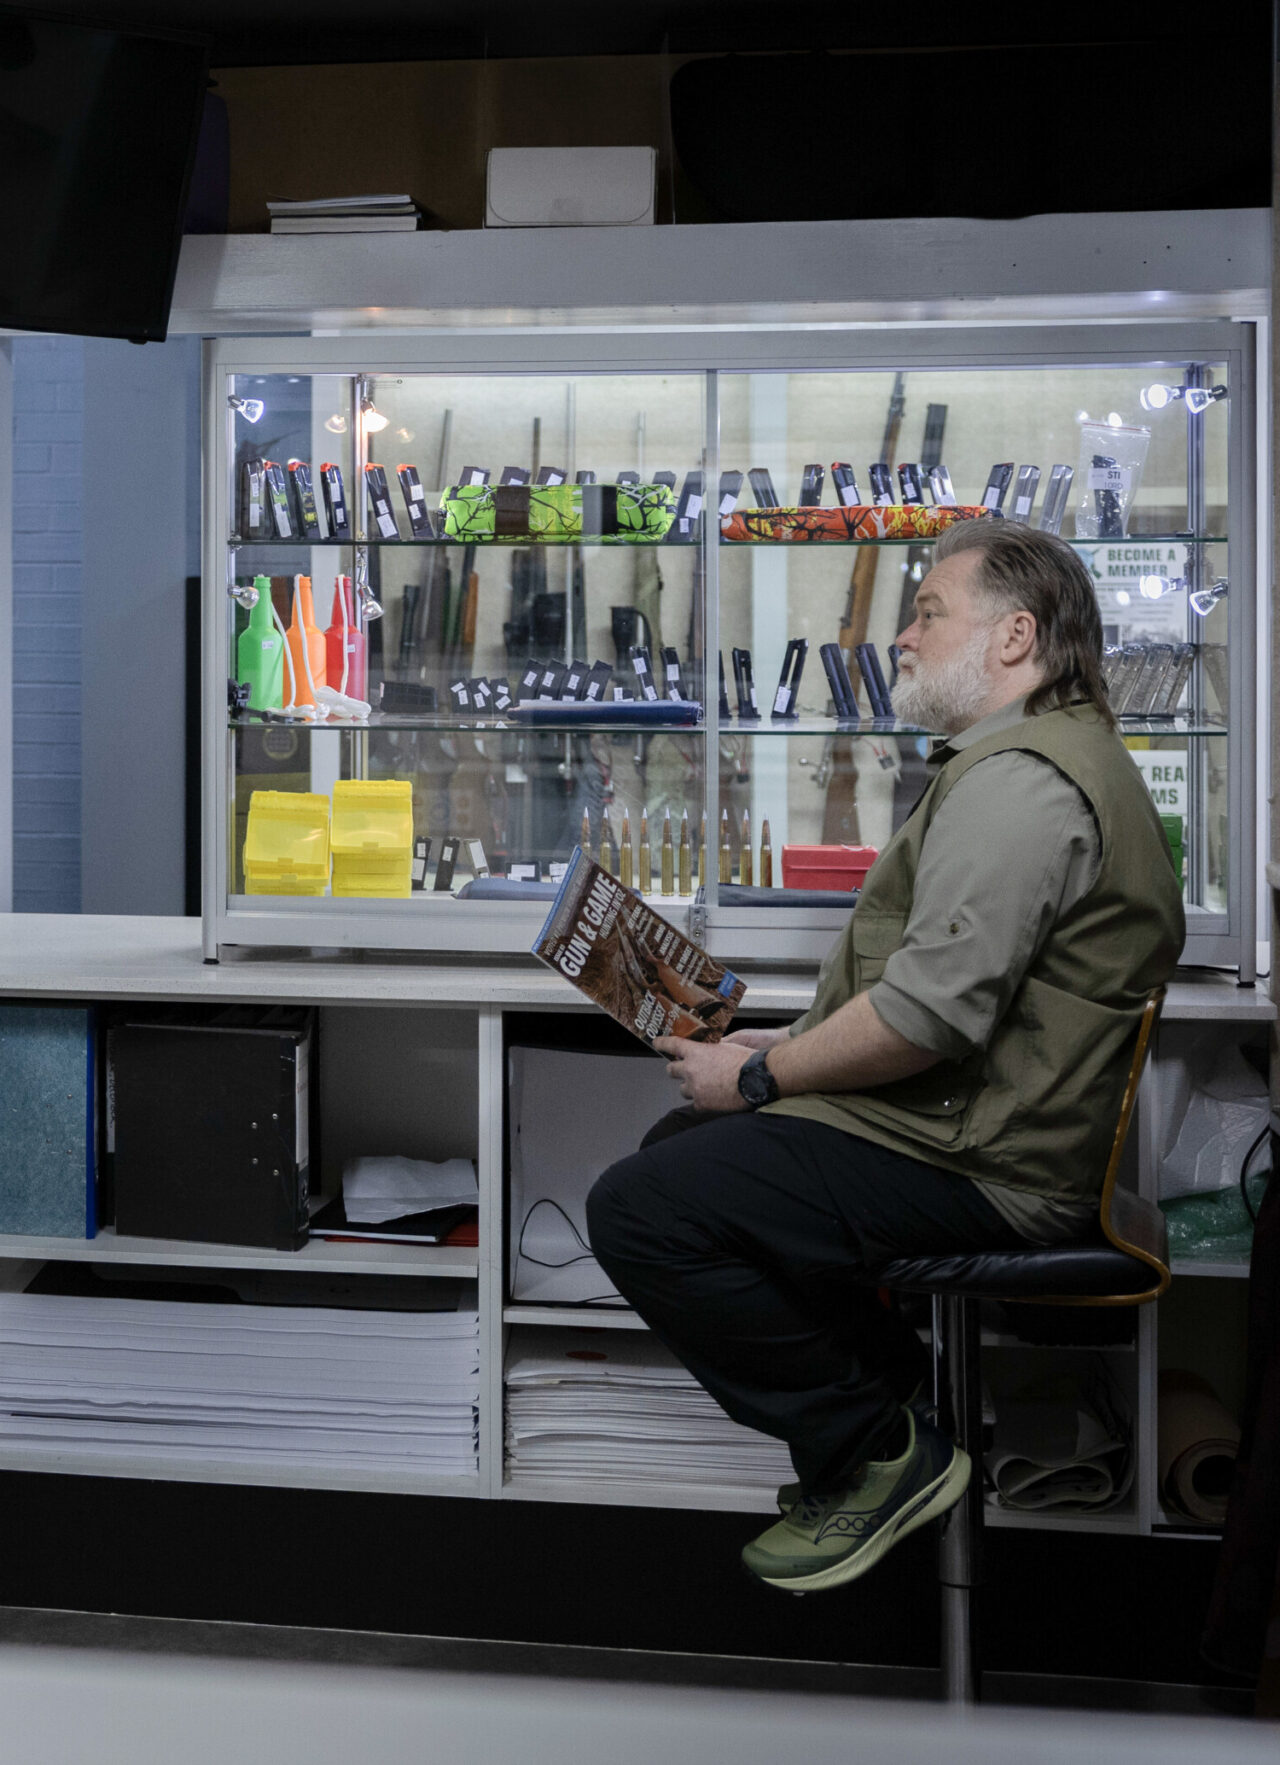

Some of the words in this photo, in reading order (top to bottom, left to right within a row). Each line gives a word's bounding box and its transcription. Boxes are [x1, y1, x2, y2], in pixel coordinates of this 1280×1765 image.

[1107, 471, 1121, 479] STI
[1107, 549, 1162, 562] BECOME
[1167, 549, 1176, 561] A
[1108, 565, 1168, 577] MEMBER
[1152, 766, 1188, 782] REA
[581, 871, 617, 926] GAME
[611, 898, 620, 909] IN
[614, 887, 625, 901] OZ
[576, 919, 597, 941] &
[598, 906, 618, 939] HUNTING
[653, 923, 666, 942] AMMO
[658, 929, 674, 955] ANALYSIS
[558, 932, 592, 978] GUN
[679, 944, 692, 964] TARGET
[633, 989, 657, 1030] OUTBACK
[644, 1000, 667, 1040] ODYSSEY
